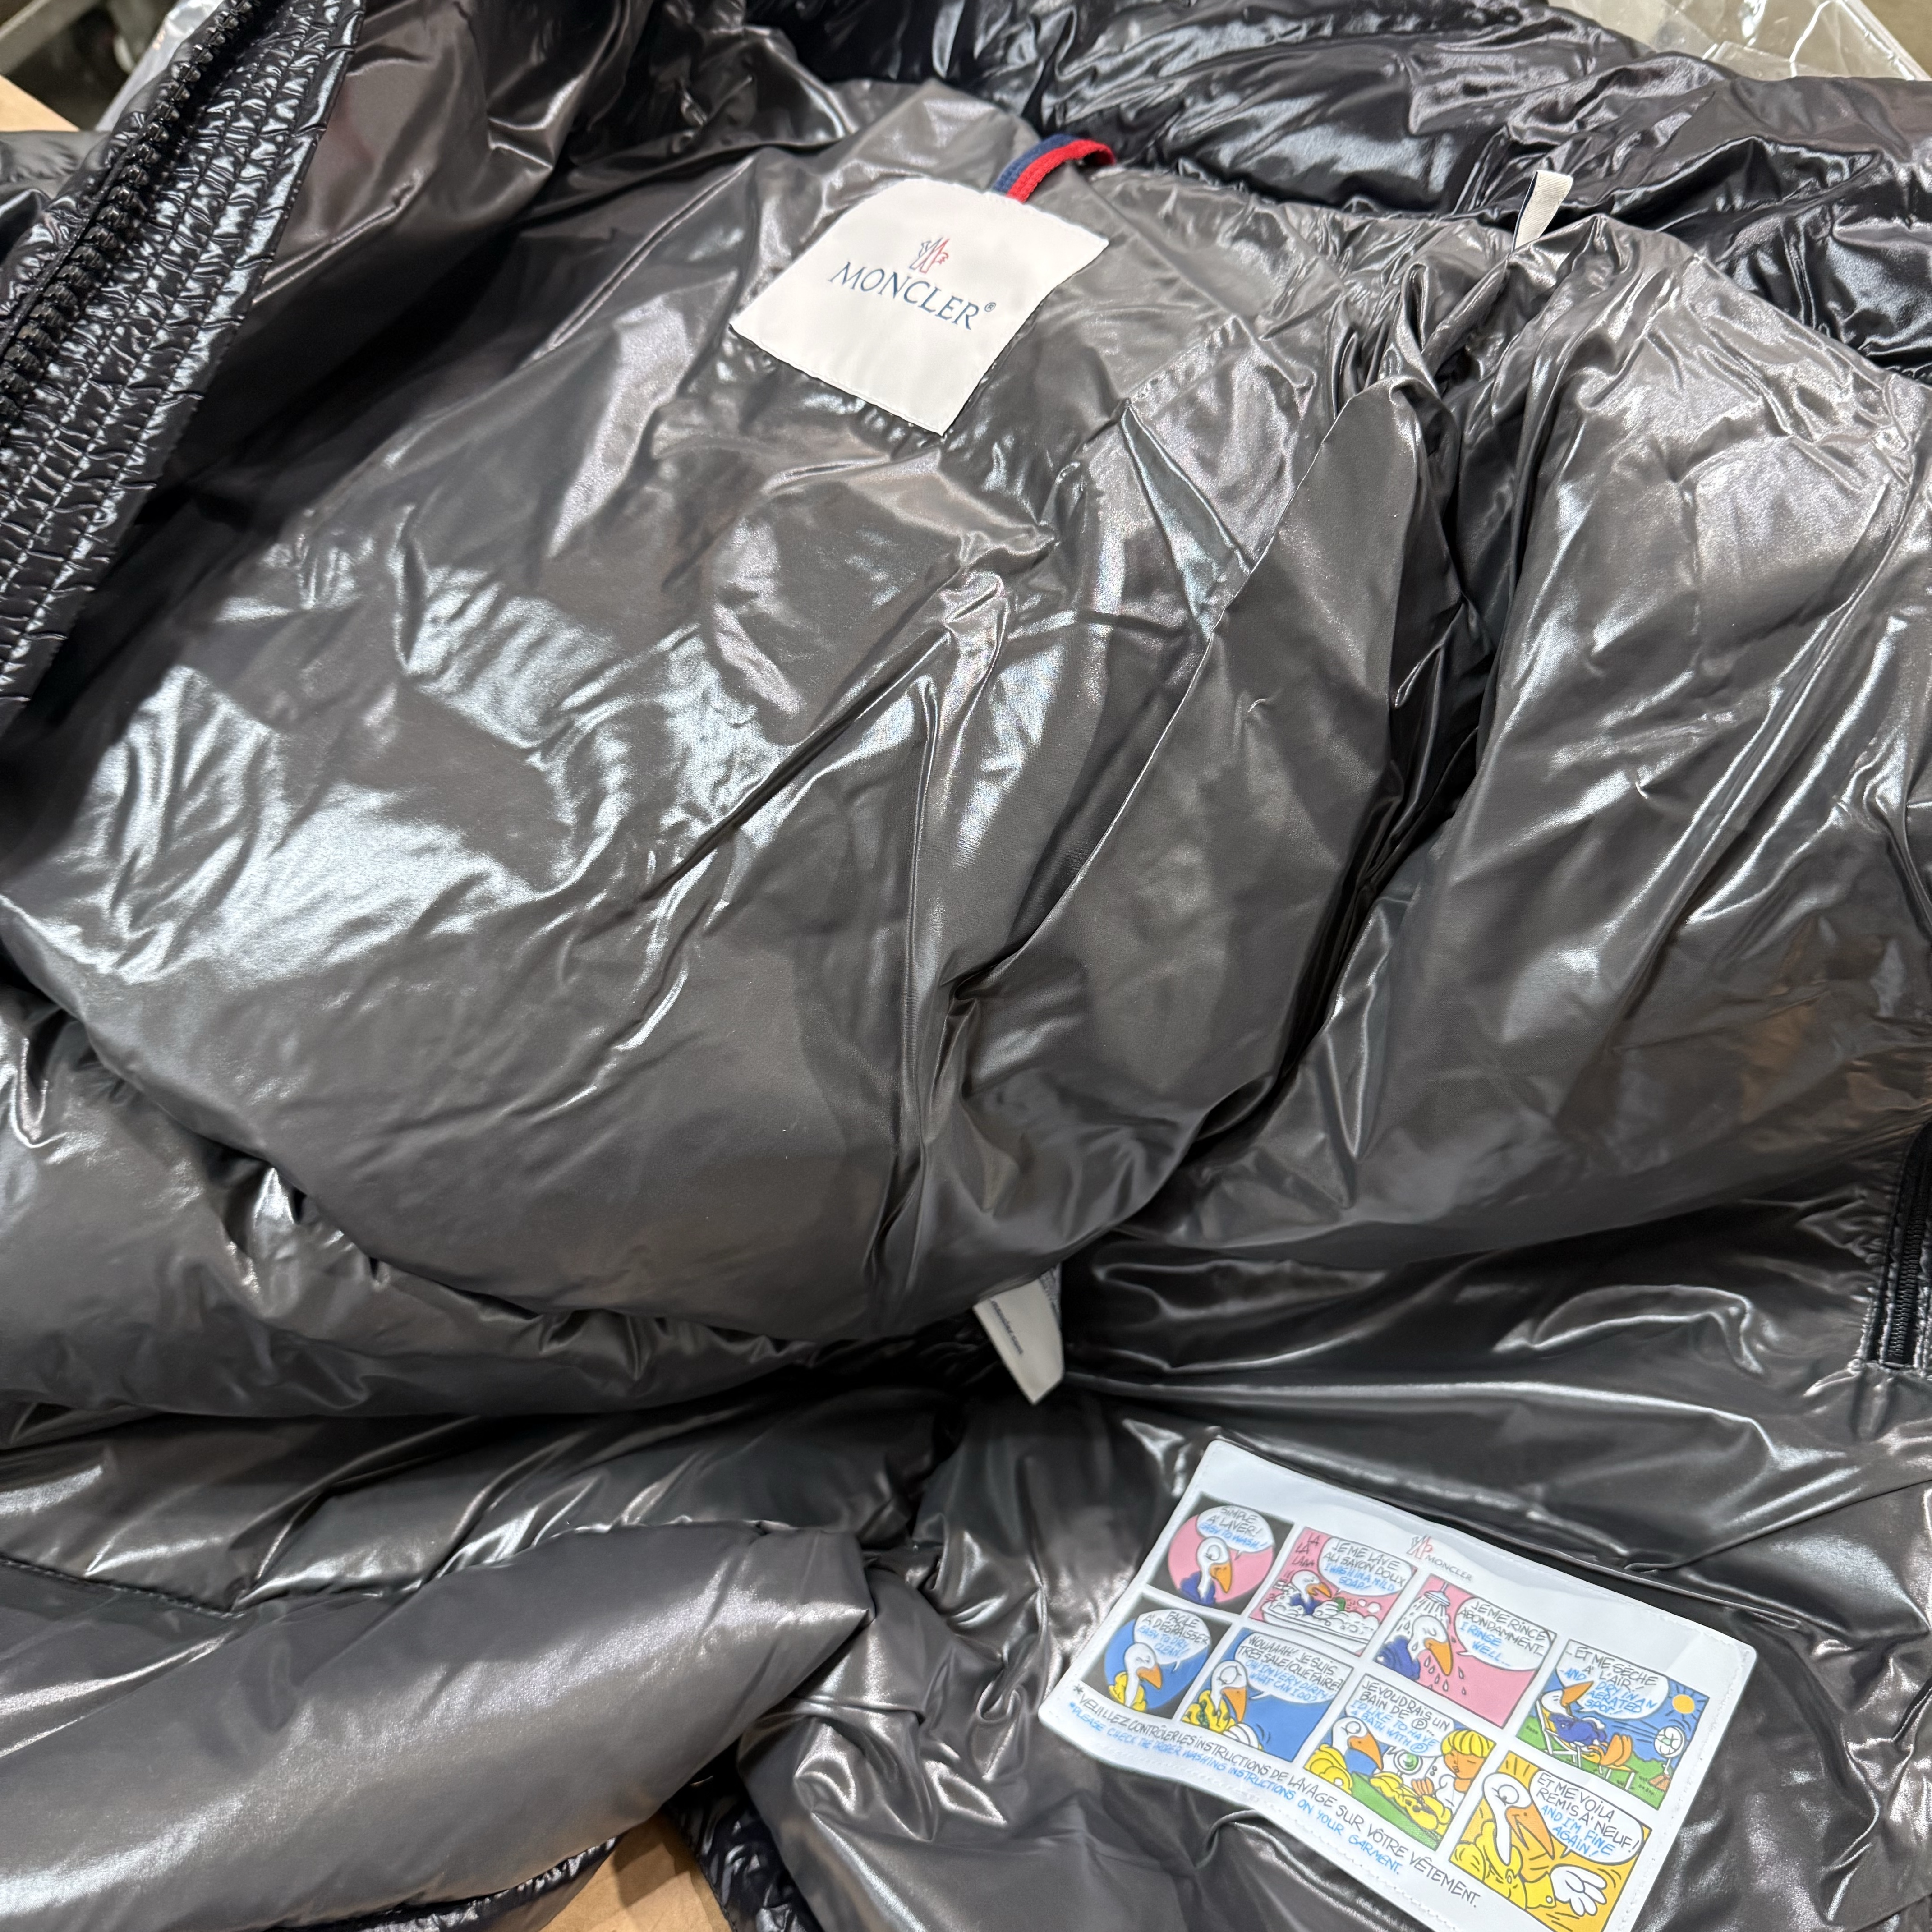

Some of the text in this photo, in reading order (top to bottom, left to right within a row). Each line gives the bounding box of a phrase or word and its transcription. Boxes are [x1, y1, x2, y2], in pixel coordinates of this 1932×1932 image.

[1219, 1518, 1264, 1537] LAVER!
[1220, 1508, 1258, 1524] SIMPLE
[1199, 1522, 1268, 1549] EASY TO WASH!
[1307, 1533, 1320, 1546] LA
[1295, 1543, 1310, 1555] LA
[1348, 1545, 1368, 1558] ME
[1368, 1551, 1400, 1570] LAVE
[1323, 1552, 1406, 1587] AU SAVON DOUX
[1329, 1566, 1352, 1578] WASH
[1364, 1573, 1371, 1582] A
[1371, 1578, 1395, 1592] MILD
[1425, 1554, 1472, 1581] MONCLER
[1339, 1576, 1372, 1590] SOAP!
[1166, 1611, 1200, 1628] FACILE
[1471, 1601, 1546, 1641] JE ME RINCE
[1138, 1625, 1190, 1649] EASY TO DRY
[1459, 1621, 1502, 1646] I RINSE
[1154, 1643, 1190, 1658] CLEAN!
[1592, 1654, 1615, 1669] ME
[1288, 1663, 1313, 1679] QUE
[1295, 1652, 1312, 1664] JE
[1310, 1657, 1338, 1676] SUIS
[1249, 1673, 1274, 1685] WHAT
[1274, 1680, 1292, 1693] CAN
[1296, 1692, 1318, 1702] DO?
[1274, 1670, 1301, 1686] VERY
[1299, 1682, 1335, 1699] DIRTY!
[1595, 1681, 1621, 1696] DRY
[1622, 1692, 1638, 1700] IN
[1599, 1670, 1644, 1693] L'AIR!
[1359, 1691, 1388, 1710] BAIN
[1389, 1706, 1412, 1719] DE
[1379, 1686, 1432, 1720] VOUDRAIS
[1432, 1717, 1450, 1732] UN
[1584, 1699, 1624, 1715] SPOT!
[1587, 1690, 1642, 1713] AERATED
[1350, 1699, 1440, 1747] I'D LIKE TO HAVE
[1361, 1712, 1385, 1731] BATH
[1387, 1728, 1412, 1746] WITH
[1107, 1727, 1135, 1744] CHECK
[1152, 1739, 1182, 1755] PROPER
[1182, 1748, 1226, 1771] WASHING
[1228, 1767, 1296, 1800] INSTRUCTIONS
[1297, 1799, 1315, 1814] ON
[1317, 1809, 1344, 1835] YOUR
[1348, 1834, 1403, 1875] GARMENT.
[1537, 1772, 1615, 1822] ET ME VOILA
[1127, 1720, 1180, 1742] CONTRÔLER
[1176, 1733, 1196, 1746] LES
[1194, 1736, 1271, 1776] INSTRUCTIONS
[1270, 1769, 1289, 1781] DE
[1287, 1775, 1338, 1808] LAVAGE
[1336, 1805, 1364, 1832] SUR
[1367, 1824, 1409, 1858] VÔTRE
[1409, 1851, 1481, 1908] VÊTEMENT.
[1536, 1787, 1579, 1817] REMIS
[1594, 1820, 1640, 1853] NEUF!
[1541, 1805, 1615, 1855] AND I'M FINE
[1552, 1826, 1599, 1857] AGAIN!
